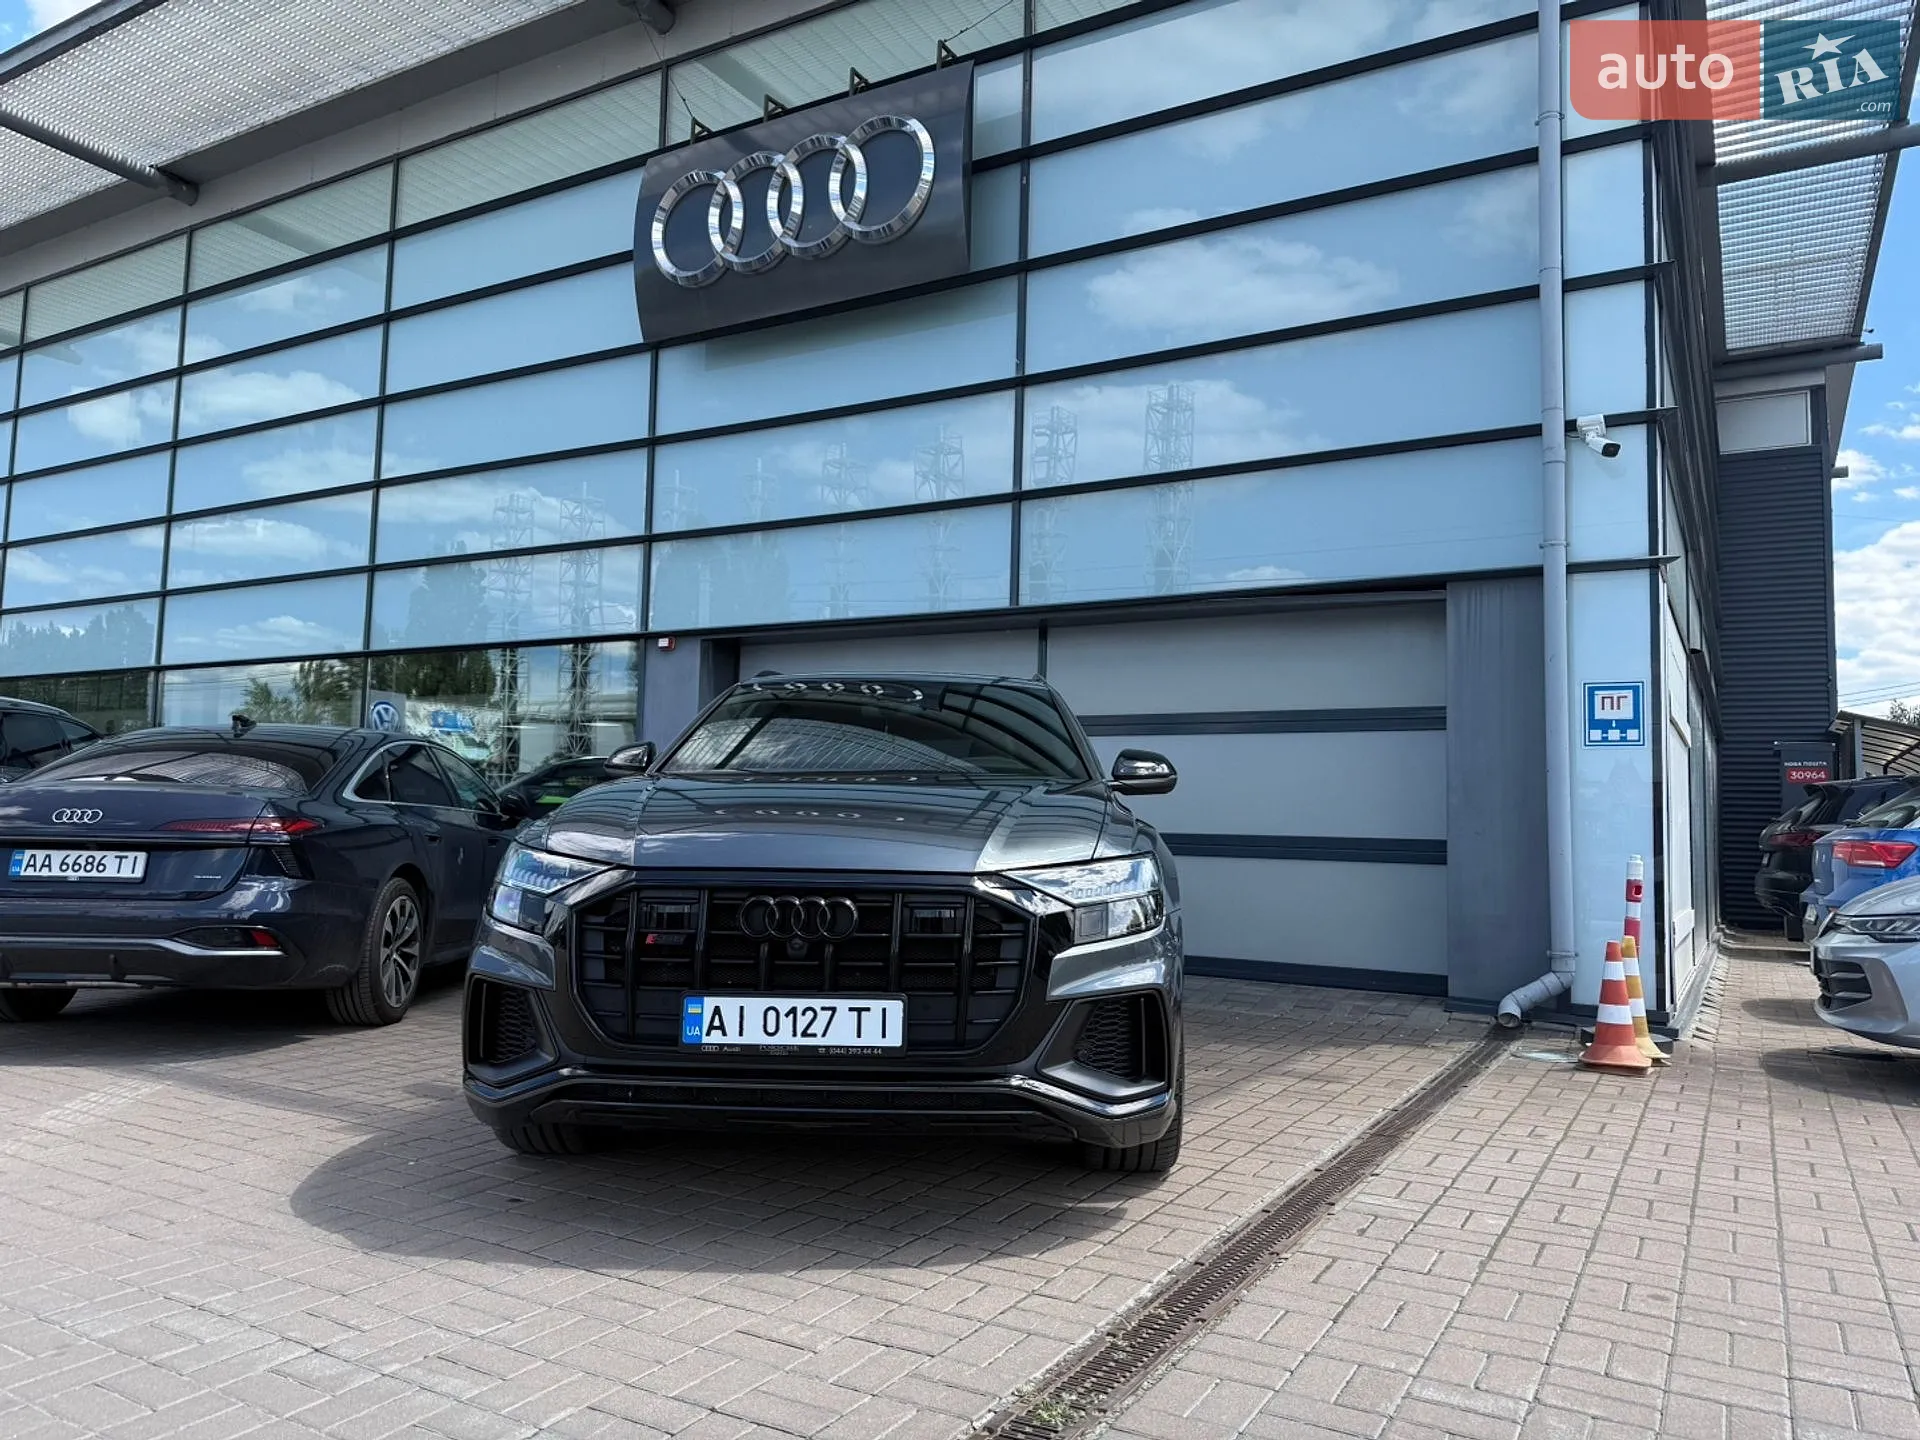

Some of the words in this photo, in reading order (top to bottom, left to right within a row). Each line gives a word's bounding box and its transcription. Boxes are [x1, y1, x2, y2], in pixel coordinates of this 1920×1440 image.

[1601, 696, 1628, 710] ПГ
[1790, 770, 1826, 780] 30964
[23, 853, 52, 872] AA
[59, 854, 107, 873] 6686
[114, 855, 139, 875] TI
[705, 1005, 745, 1038] AI
[762, 1006, 837, 1038] 0127
[848, 1006, 887, 1039] TI
[686, 1026, 700, 1036] UA
